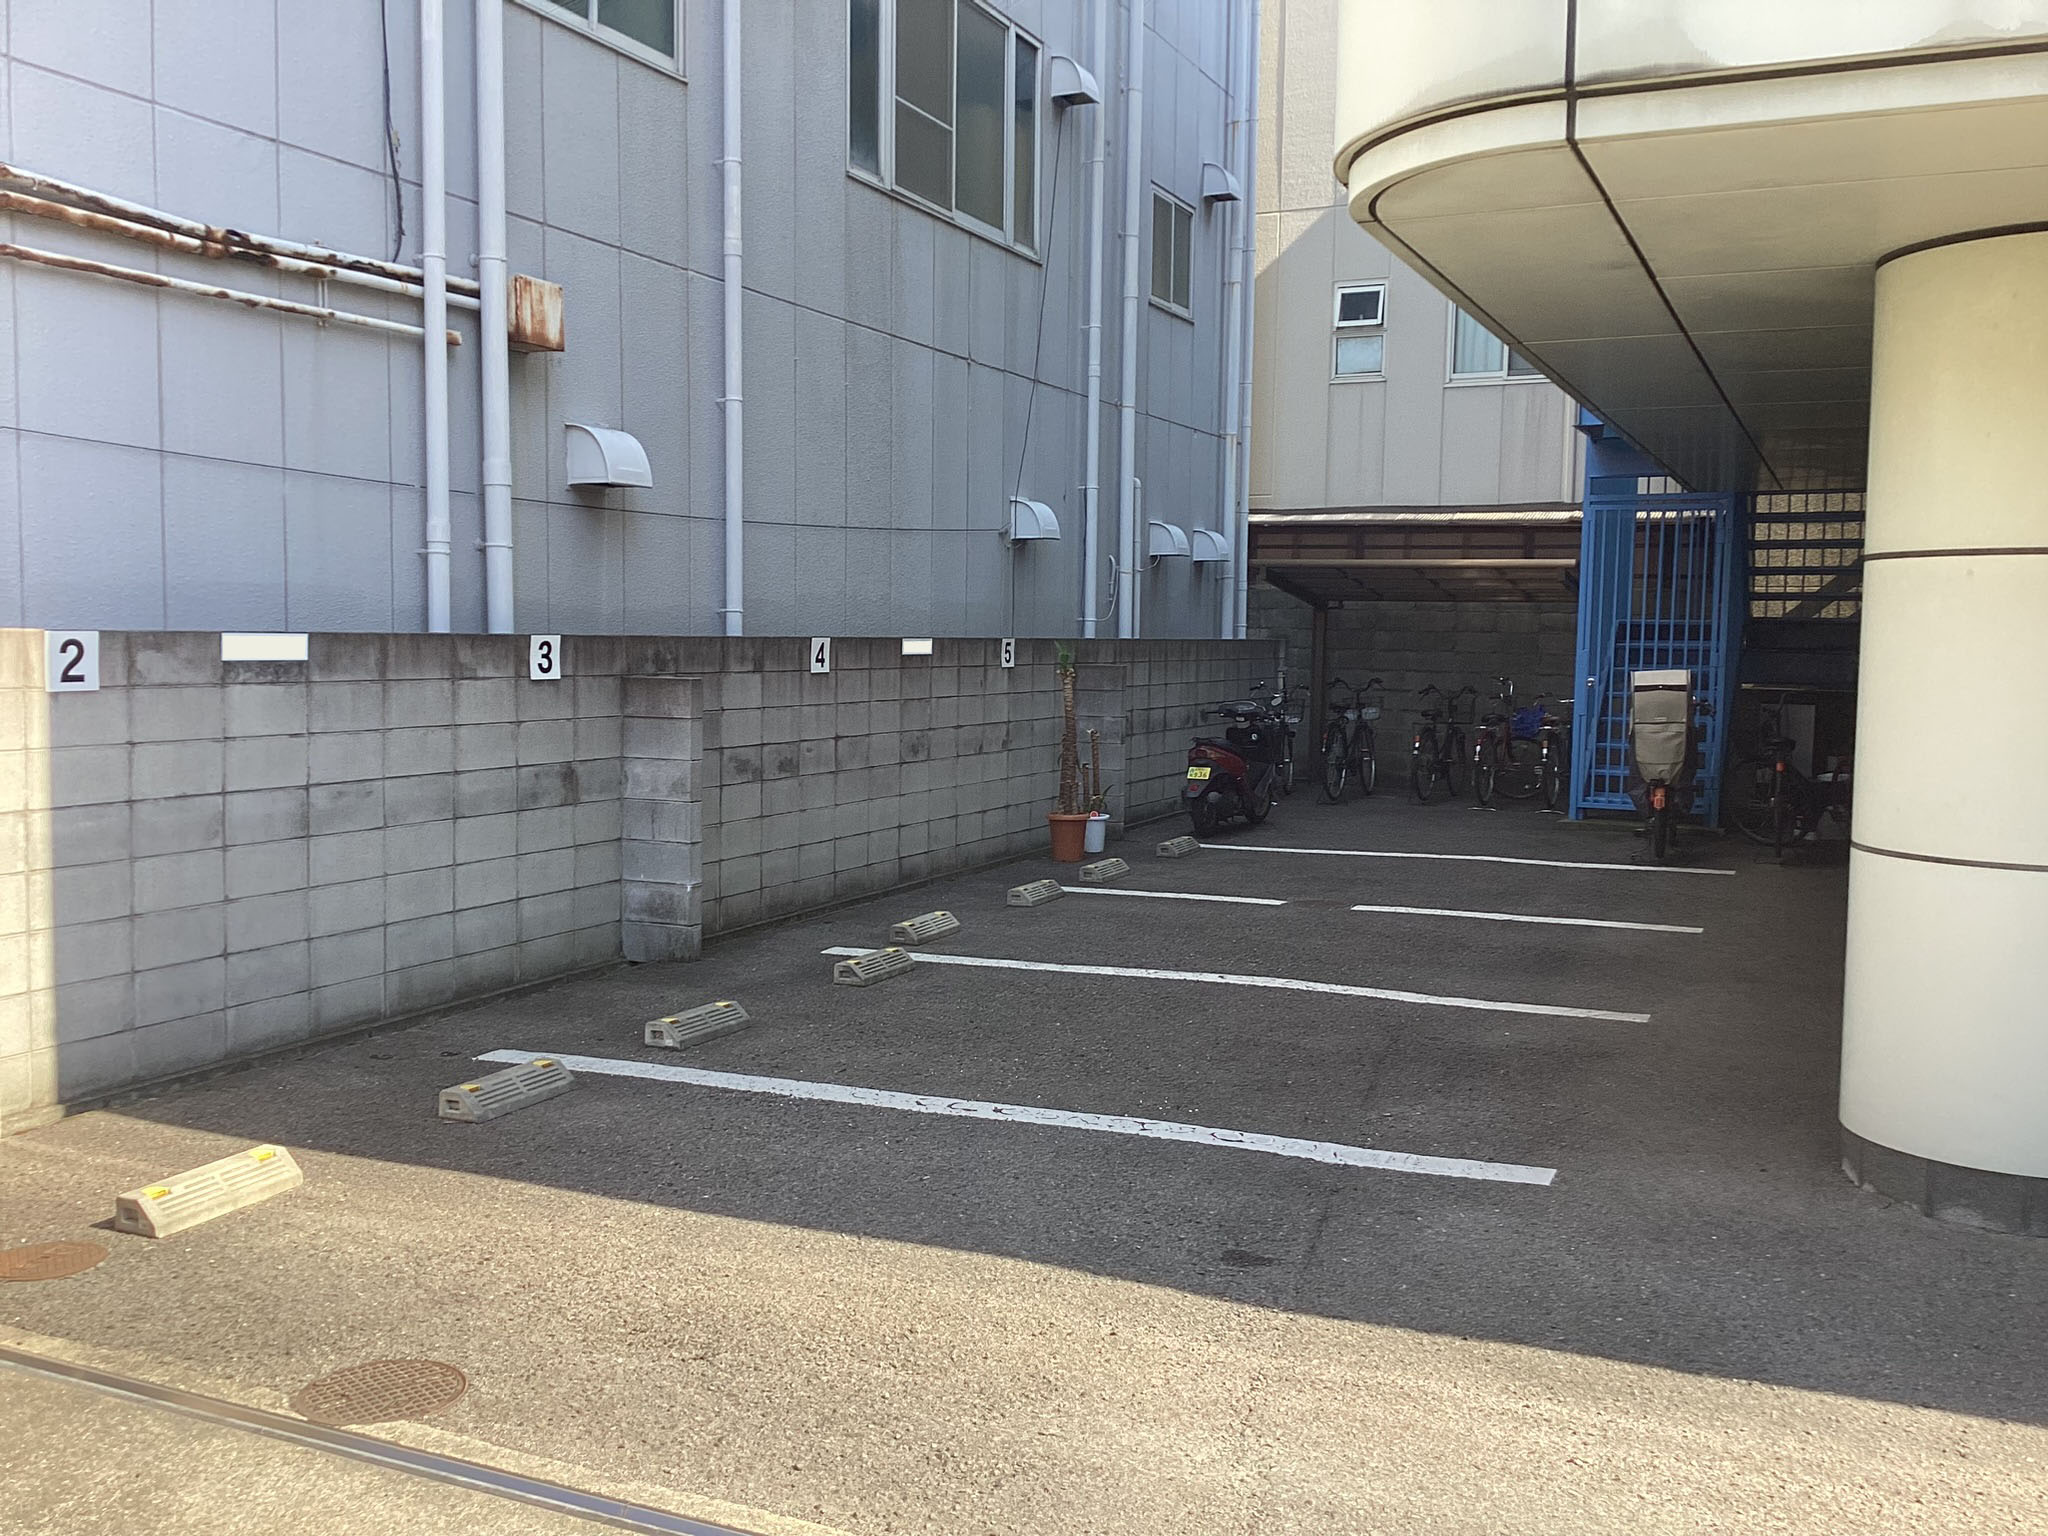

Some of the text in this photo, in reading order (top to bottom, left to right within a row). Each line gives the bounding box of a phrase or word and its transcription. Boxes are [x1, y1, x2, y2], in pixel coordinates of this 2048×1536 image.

[60, 638, 85, 683] 2
[537, 640, 553, 674] 3
[815, 641, 826, 668] 4
[1004, 641, 1012, 664] 5
